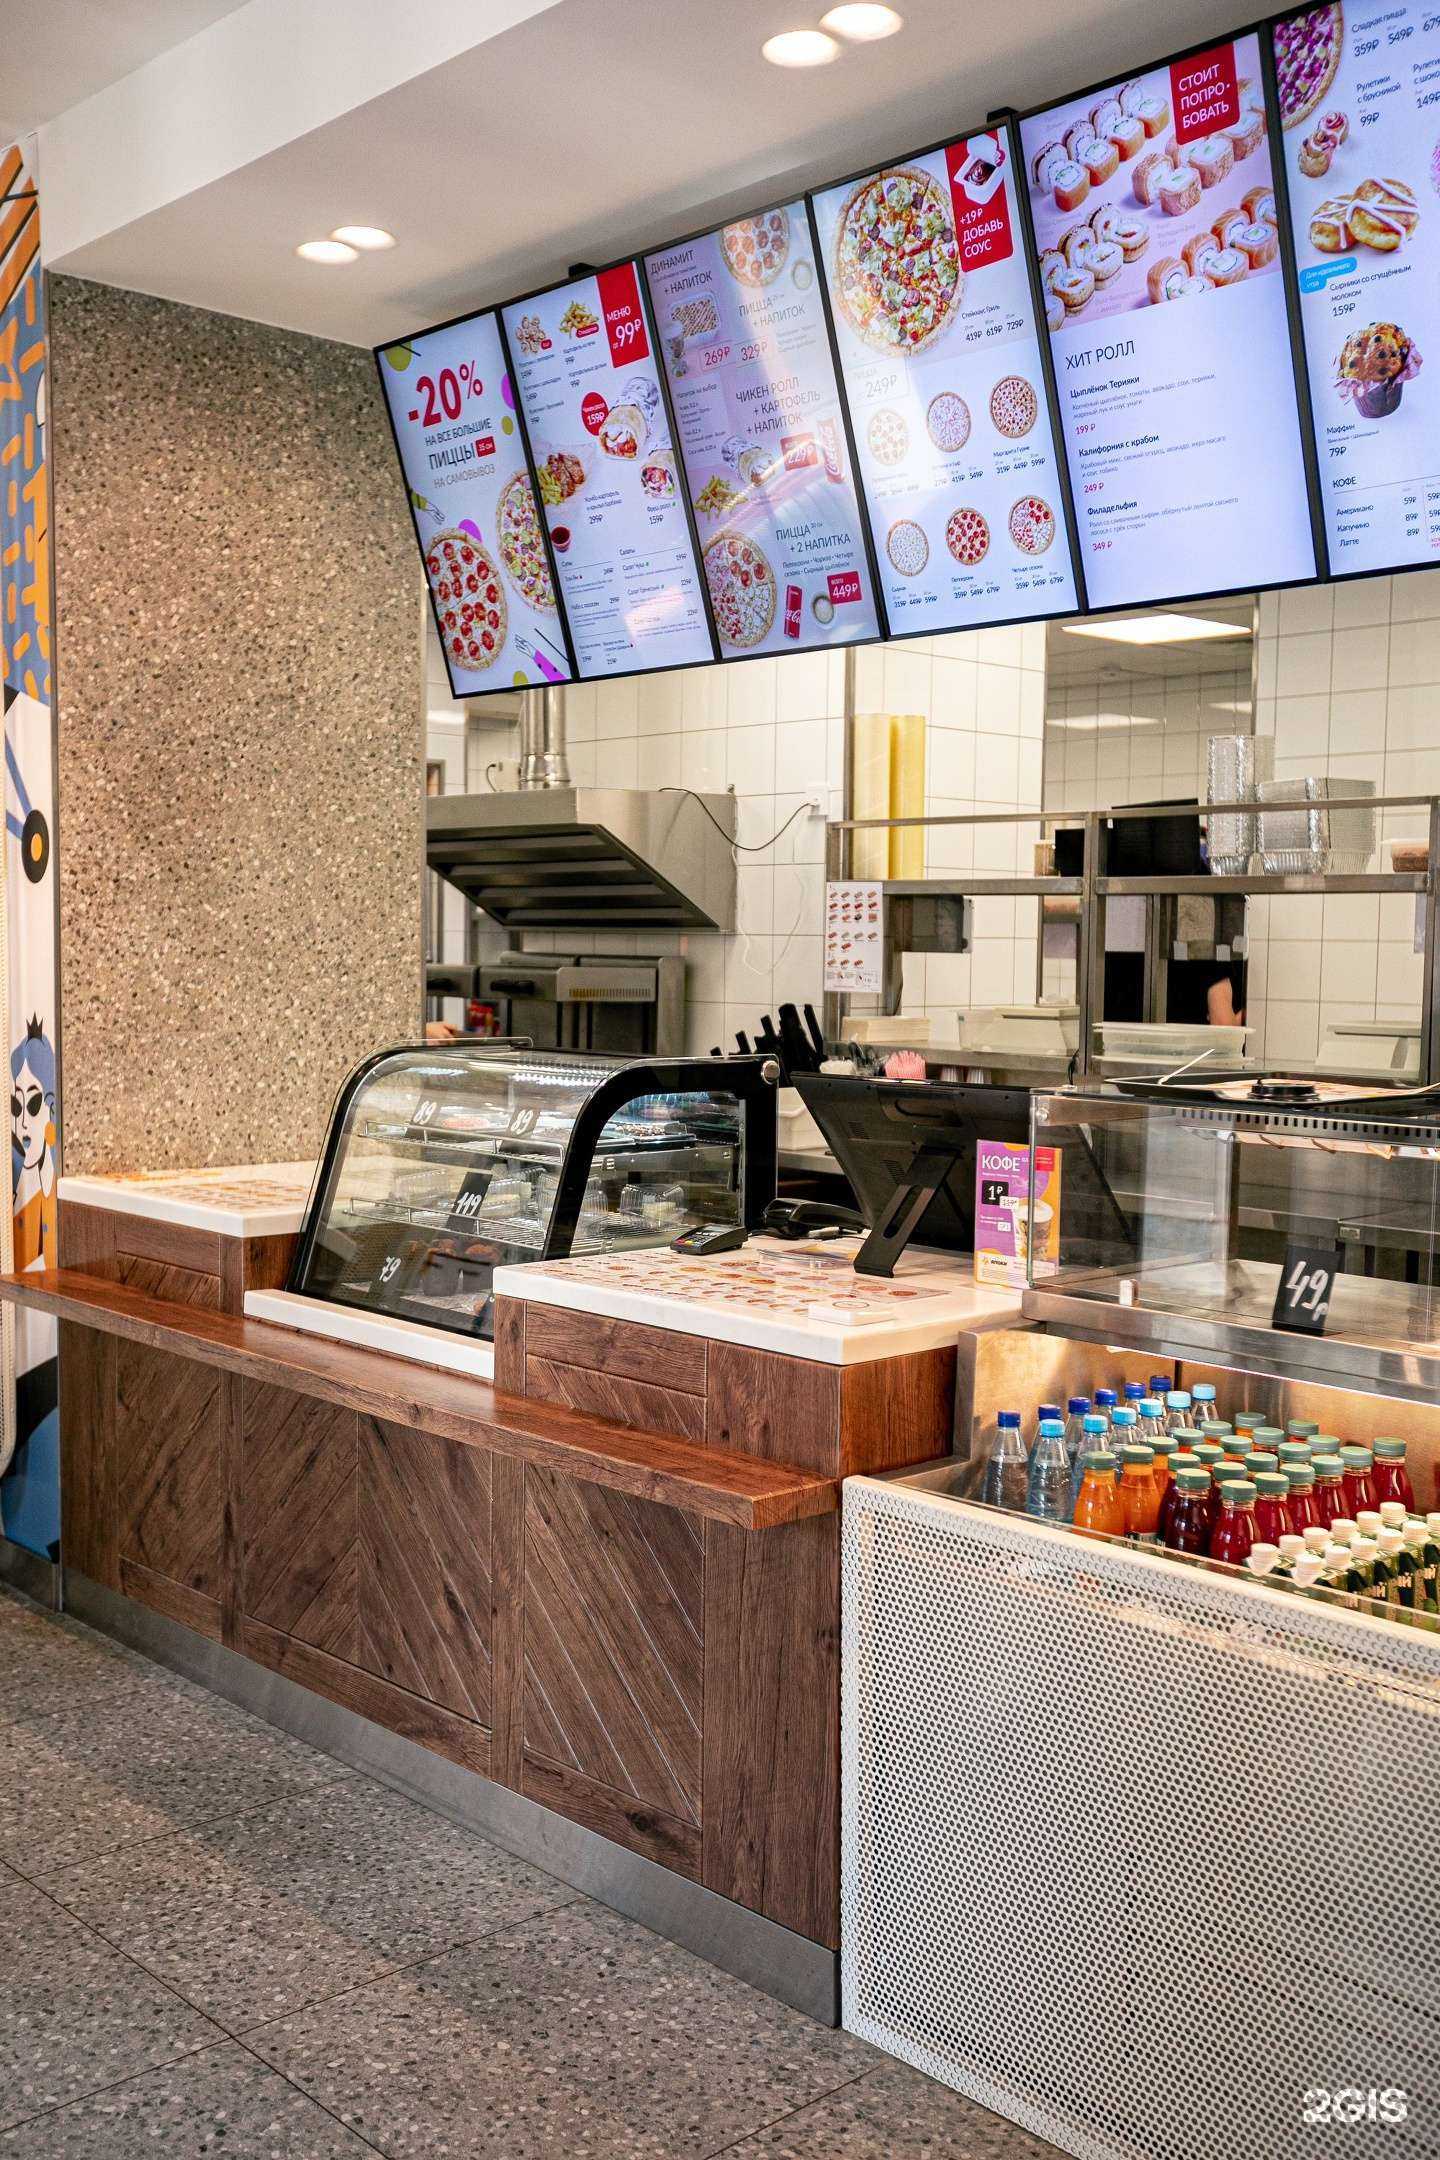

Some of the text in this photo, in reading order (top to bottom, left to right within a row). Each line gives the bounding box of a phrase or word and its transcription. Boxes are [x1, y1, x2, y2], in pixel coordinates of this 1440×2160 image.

[1178, 64, 1220, 91] СТОИТ
[1182, 100, 1230, 129] БОВАТЬ
[962, 220, 1004, 245] ДОБАВЬ
[964, 239, 993, 258] СОУС
[650, 249, 695, 275] ДИНАМИТ
[670, 271, 713, 294] НАПИТОК
[607, 305, 631, 322] МЕНЮ
[739, 297, 773, 317] ПИЦЦА
[1066, 340, 1135, 370] ХИТ РОЛЛ
[408, 360, 484, 428] -20%
[735, 376, 800, 403] ЧИКЕН РОЛЛ
[1070, 376, 1140, 399] Цыплёнок Терияки
[760, 391, 821, 414] КАРТОФЕЛЬ
[424, 418, 493, 446] НА ВСЕ БОЛЬШИЕ
[754, 415, 803, 435] НАПИТОК
[428, 443, 475, 469] ПИЦЦЫ
[1078, 441, 1124, 458] Калифорния
[1130, 435, 1160, 448] крабом
[434, 463, 495, 488] НА САМОВЫВОЗ
[1332, 476, 1357, 488] КОФЕ
[1087, 500, 1138, 516] Филадельфия
[776, 524, 811, 541] ПИЦЦА
[805, 533, 851, 551] НАПИТКА
[413, 1101, 437, 1125] 89
[511, 1109, 534, 1134] 89
[982, 1155, 1021, 1172] КОФЕ
[455, 1192, 483, 1216] 119
